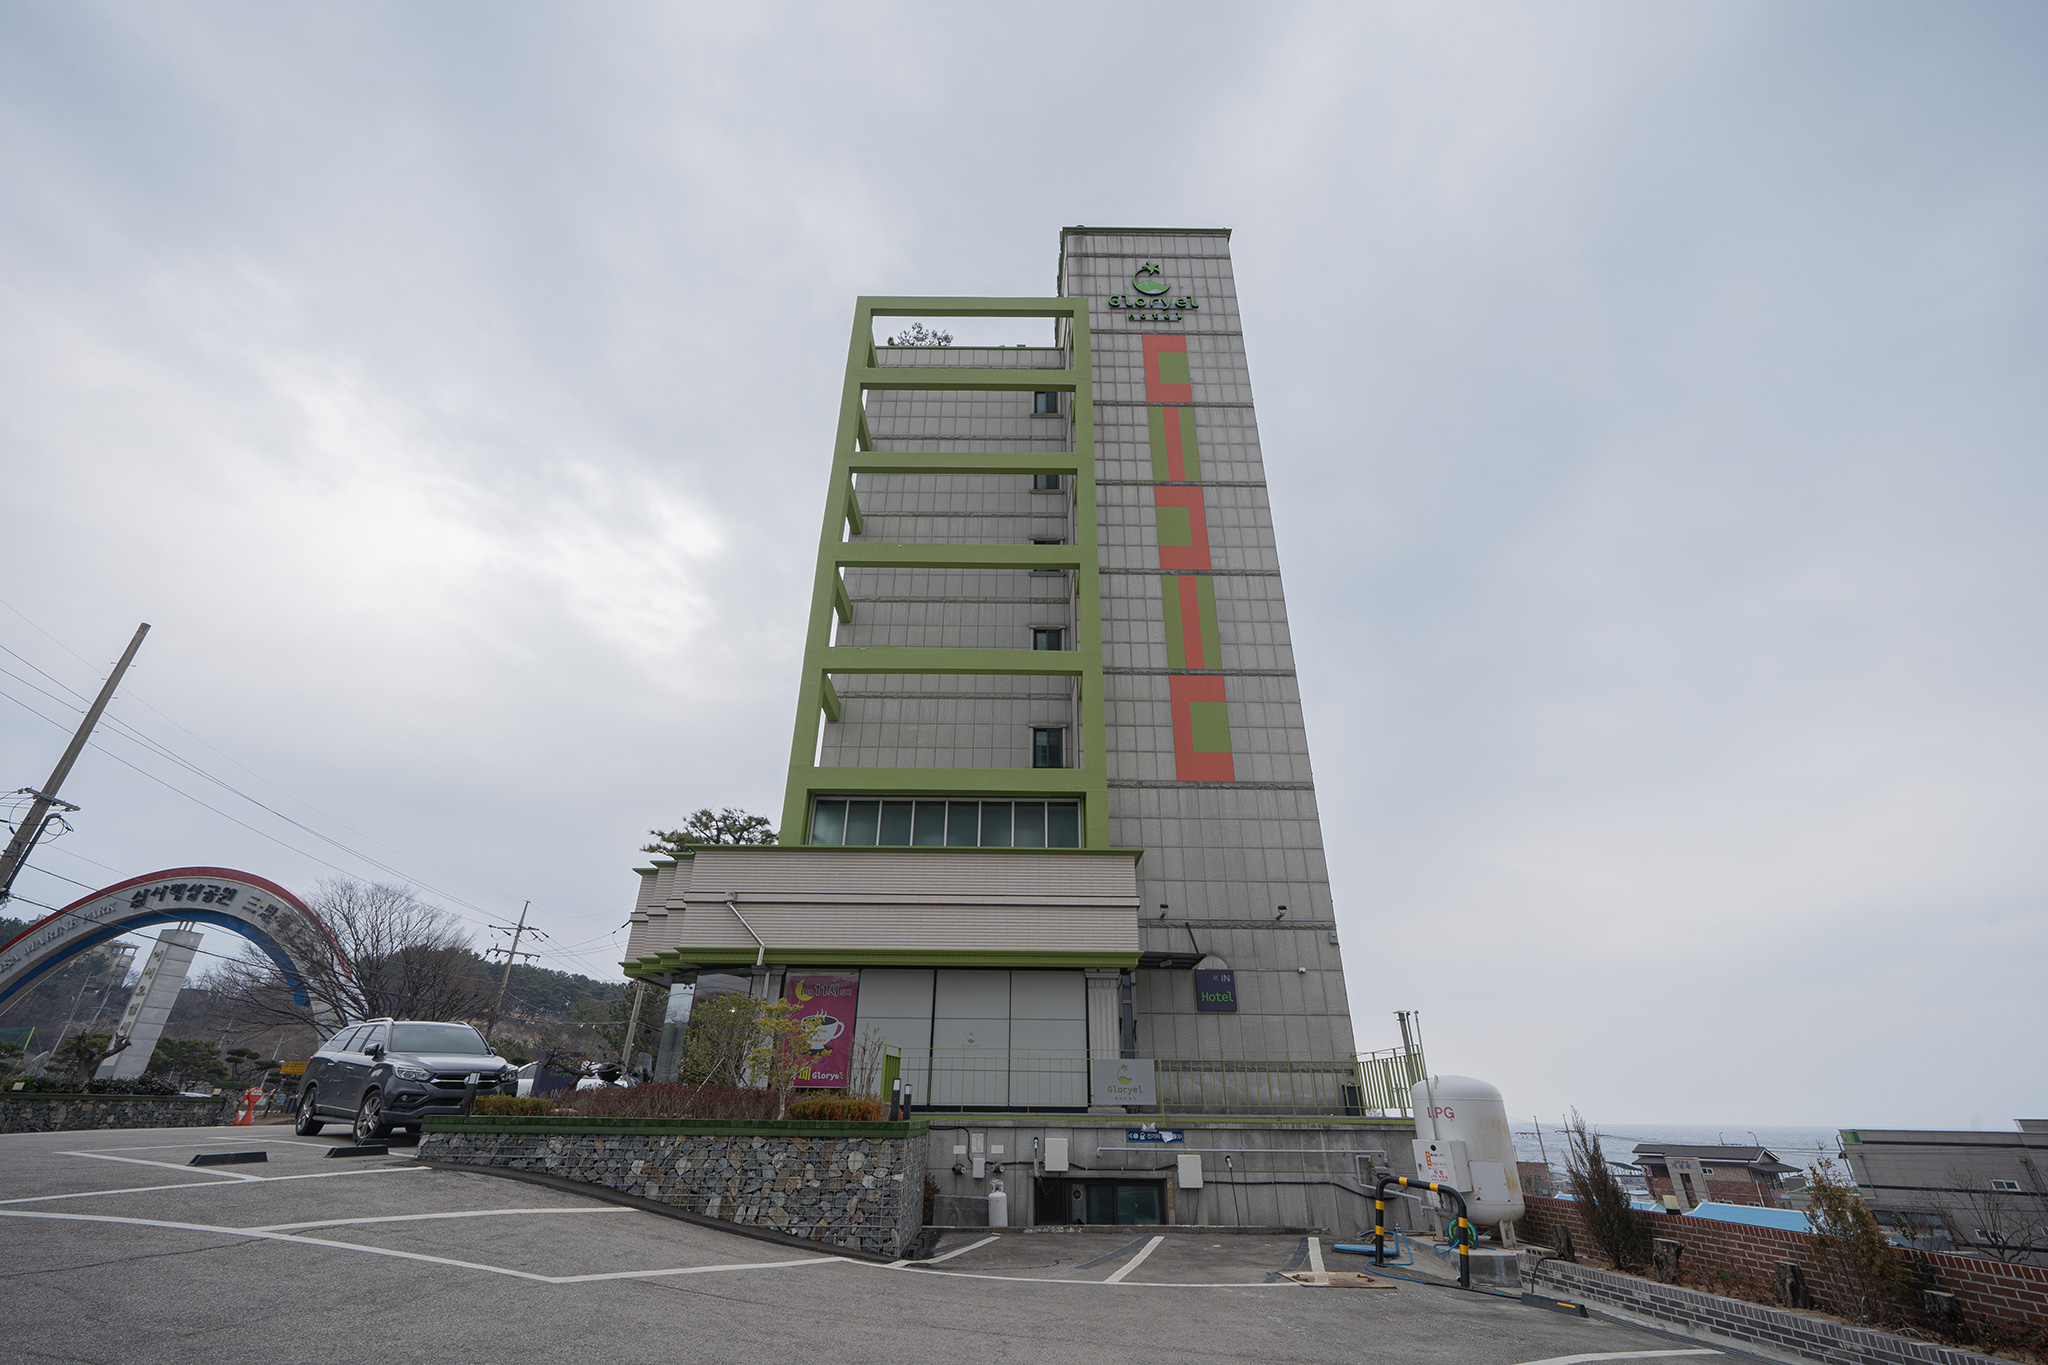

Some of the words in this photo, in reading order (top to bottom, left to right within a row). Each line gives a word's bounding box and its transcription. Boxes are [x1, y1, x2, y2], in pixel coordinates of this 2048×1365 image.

[1108, 294, 1199, 311] Gloryel
[1128, 312, 1182, 320] Hotel
[1220, 974, 1231, 983] IN
[1201, 991, 1235, 1002] Hotel
[1107, 1085, 1143, 1095] Gloryel
[1427, 1106, 1455, 1119] LPG
